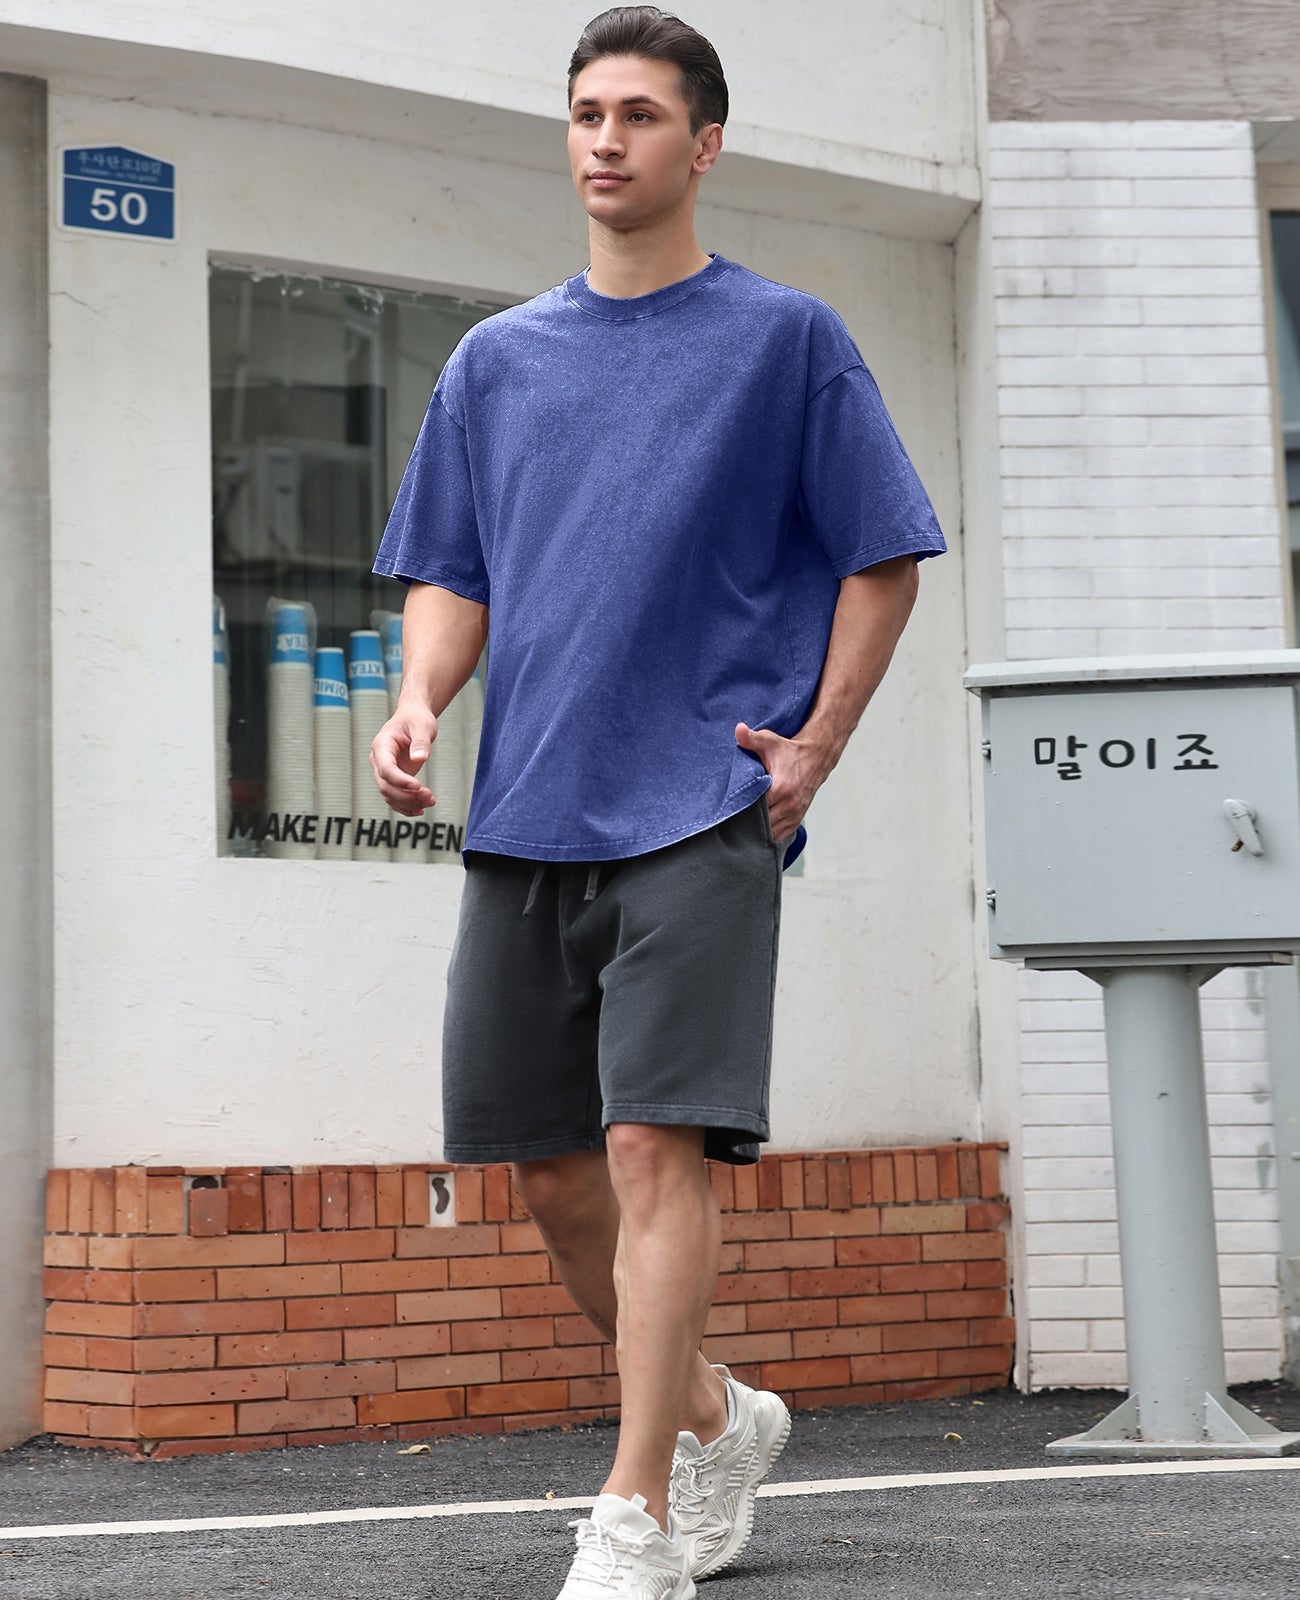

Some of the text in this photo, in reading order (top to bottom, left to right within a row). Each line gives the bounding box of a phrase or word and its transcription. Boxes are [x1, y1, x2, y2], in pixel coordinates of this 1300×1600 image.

[90, 187, 148, 226] 50
[1034, 733, 1219, 781] 말이죠
[228, 812, 463, 854] MAKE IT HAPPEN
